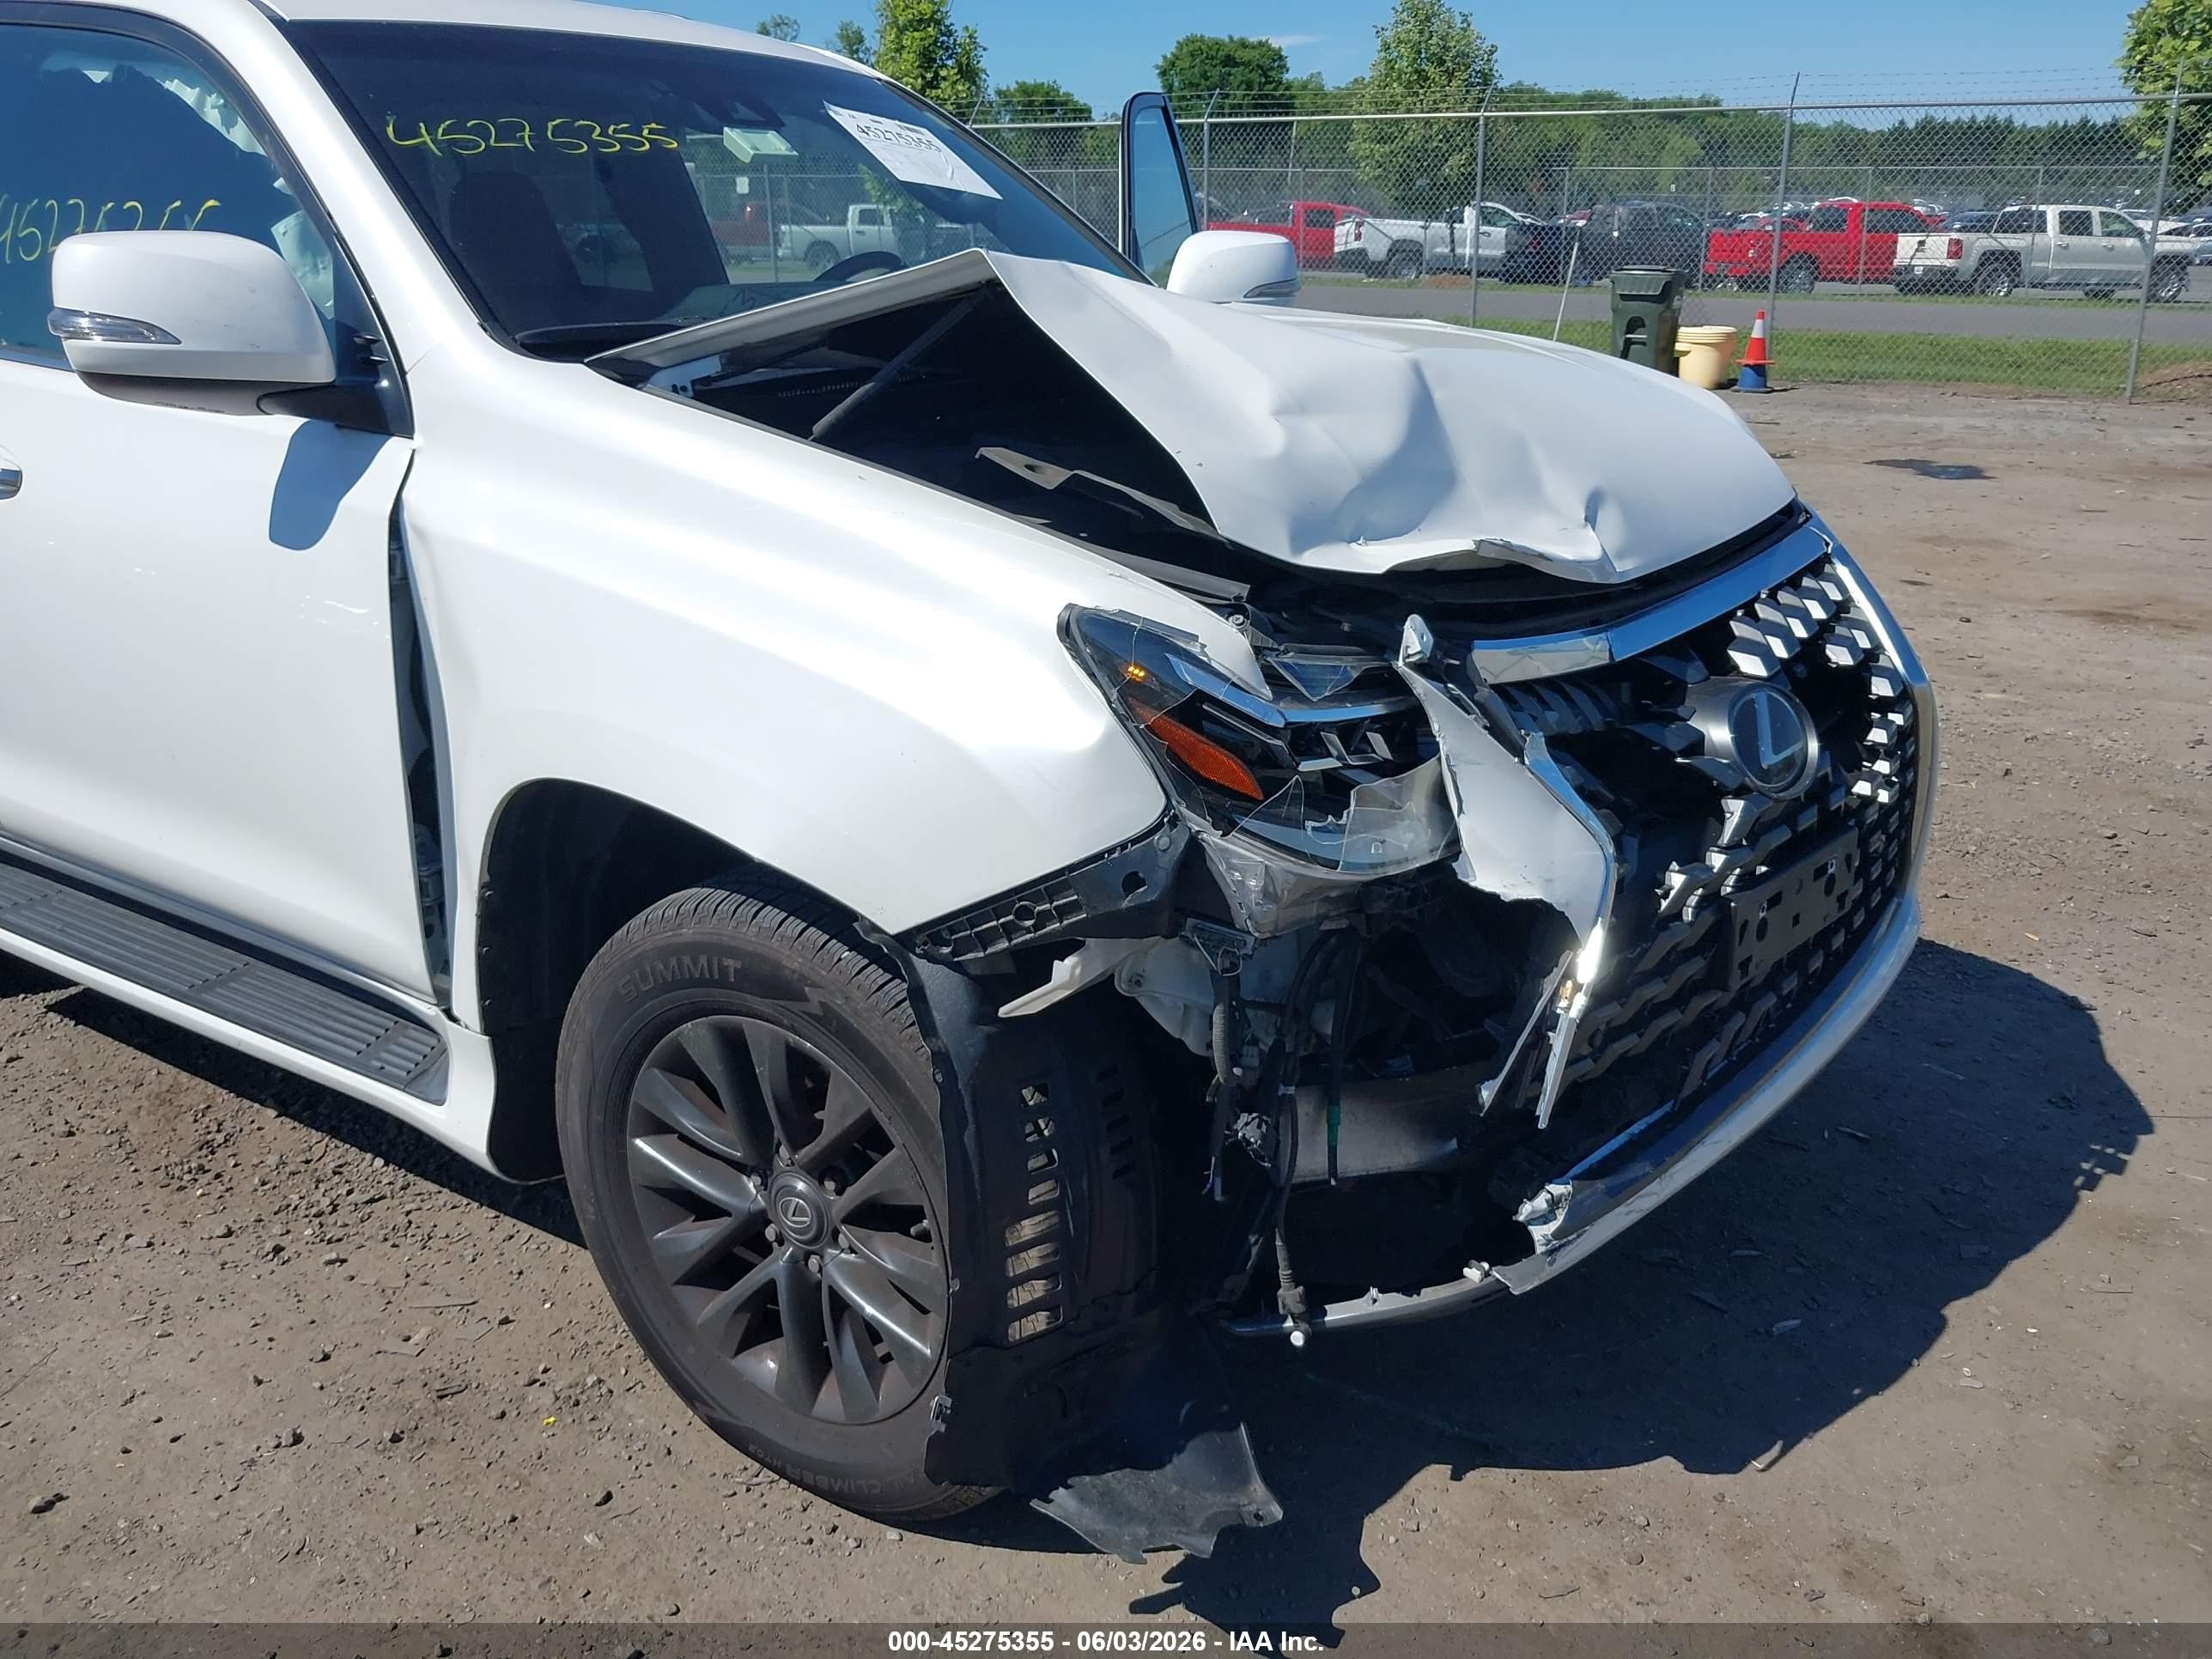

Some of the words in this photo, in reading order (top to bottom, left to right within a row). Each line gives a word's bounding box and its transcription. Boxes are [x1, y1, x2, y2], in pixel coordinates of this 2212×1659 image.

[386, 115, 678, 156] 45275355
[855, 124, 942, 153] 45275355
[618, 954, 742, 1003] SUMMIT
[786, 1464, 881, 1494] CLIMBER
